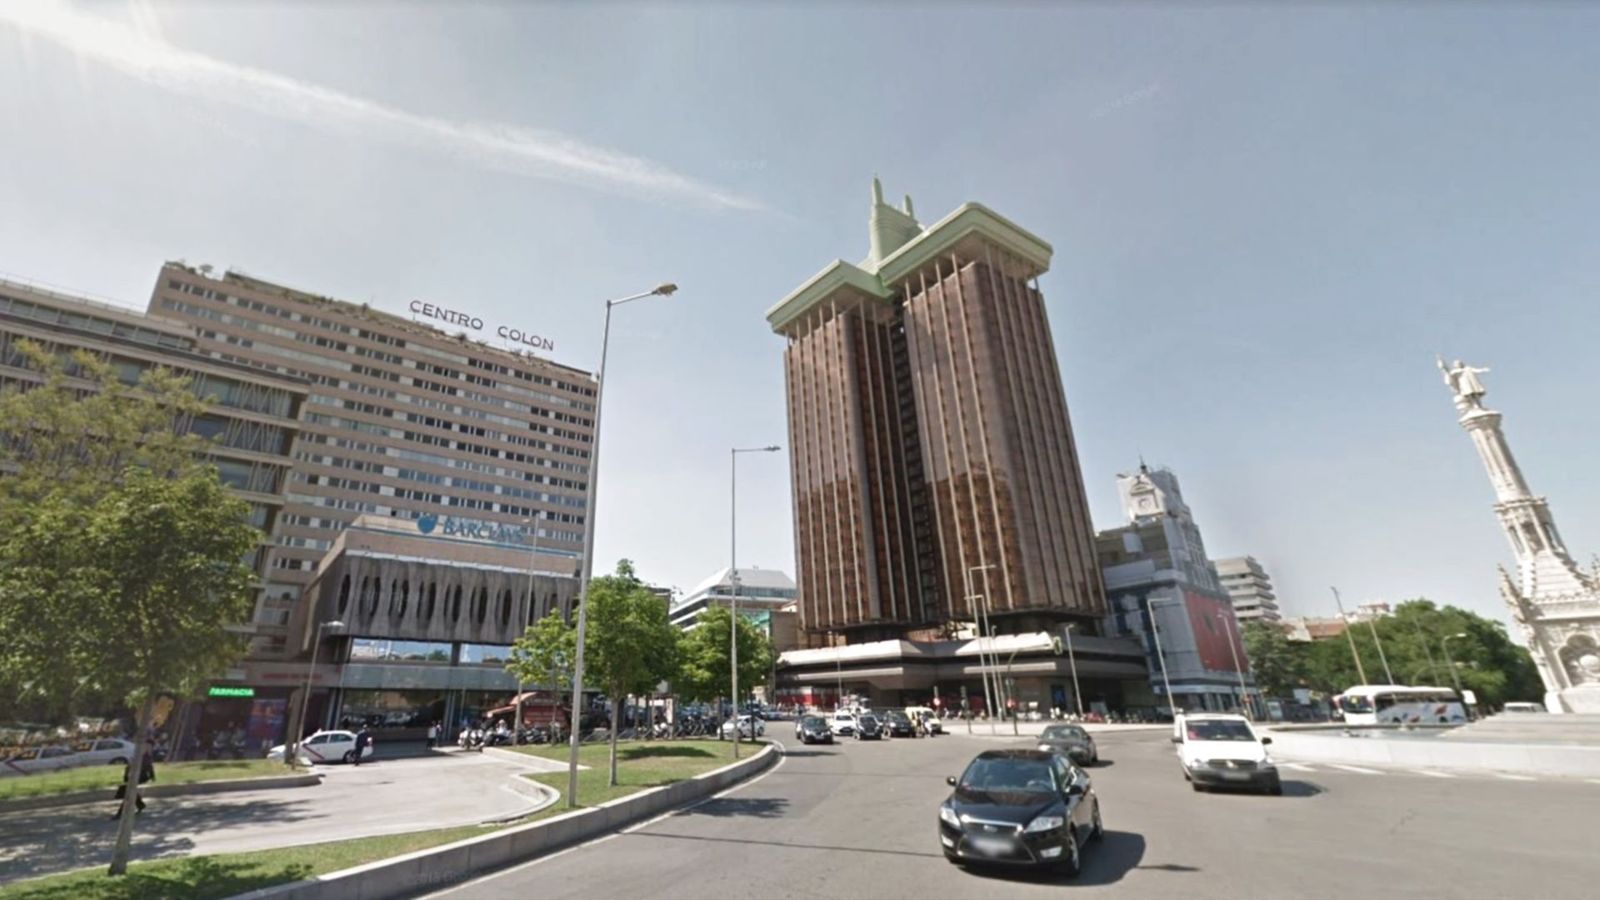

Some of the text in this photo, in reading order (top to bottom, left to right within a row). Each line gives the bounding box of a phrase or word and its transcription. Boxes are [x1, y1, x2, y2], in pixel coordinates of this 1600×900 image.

[409, 300, 555, 351] CENTRO COLON
[443, 516, 526, 542] BARCLAYS
[208, 687, 255, 697] FARMACIA
